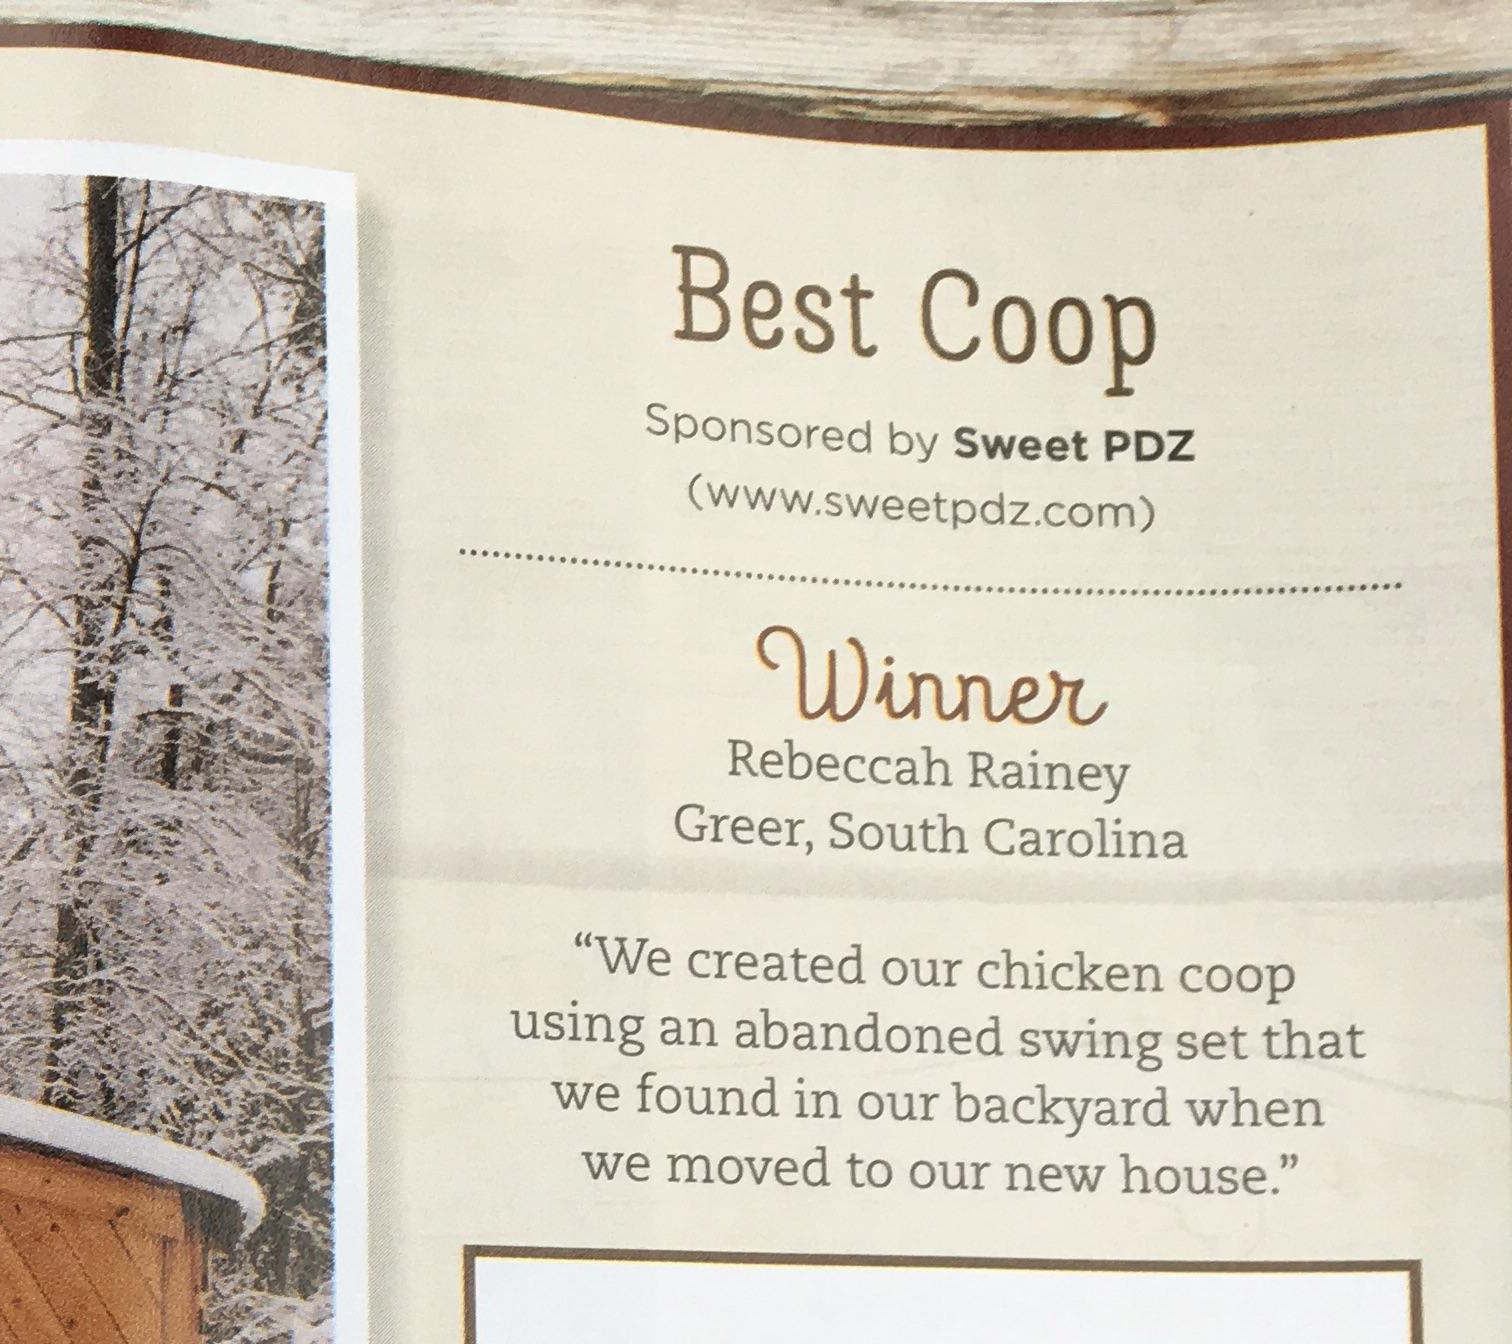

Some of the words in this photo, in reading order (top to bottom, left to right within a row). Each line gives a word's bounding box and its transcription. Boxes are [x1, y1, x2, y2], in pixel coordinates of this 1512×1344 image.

[672, 244, 878, 358] Best
[921, 268, 1156, 397] Coop
[646, 403, 871, 453] Sponsored
[889, 421, 938, 463] by
[954, 426, 1088, 462] Sweet
[1105, 430, 1195, 462] PDZ
[688, 473, 1155, 533] (www.sweetpdz.com)
[757, 625, 1108, 726] Winner
[728, 739, 953, 787] Rebeccah
[968, 749, 1131, 804] Rainey
[675, 803, 813, 856] Greer,
[829, 812, 968, 854] South
[984, 818, 1188, 859] Carolina
[574, 931, 671, 976] “We
[688, 944, 866, 984] created
[882, 957, 963, 987] our
[978, 948, 1164, 992] chicken
[1180, 964, 1295, 1005] coop
[510, 1000, 645, 1057] using
[660, 1016, 718, 1047] an
[736, 1008, 1004, 1056] abandoned
[1020, 1018, 1162, 1072] swing
[1177, 1026, 1248, 1060] set
[1262, 1019, 1366, 1060] that
[551, 1081, 620, 1112] we
[637, 1071, 779, 1117] found
[795, 1077, 842, 1119] in
[858, 1092, 940, 1121] our
[951, 1081, 1171, 1138] backyard
[1185, 1086, 1325, 1127] when
[581, 1152, 650, 1182] we
[667, 1146, 831, 1187] moved
[846, 1153, 893, 1188] to
[910, 1160, 991, 1190] our
[1005, 1163, 1106, 1192] new
[1119, 1153, 1298, 1195] house.”
